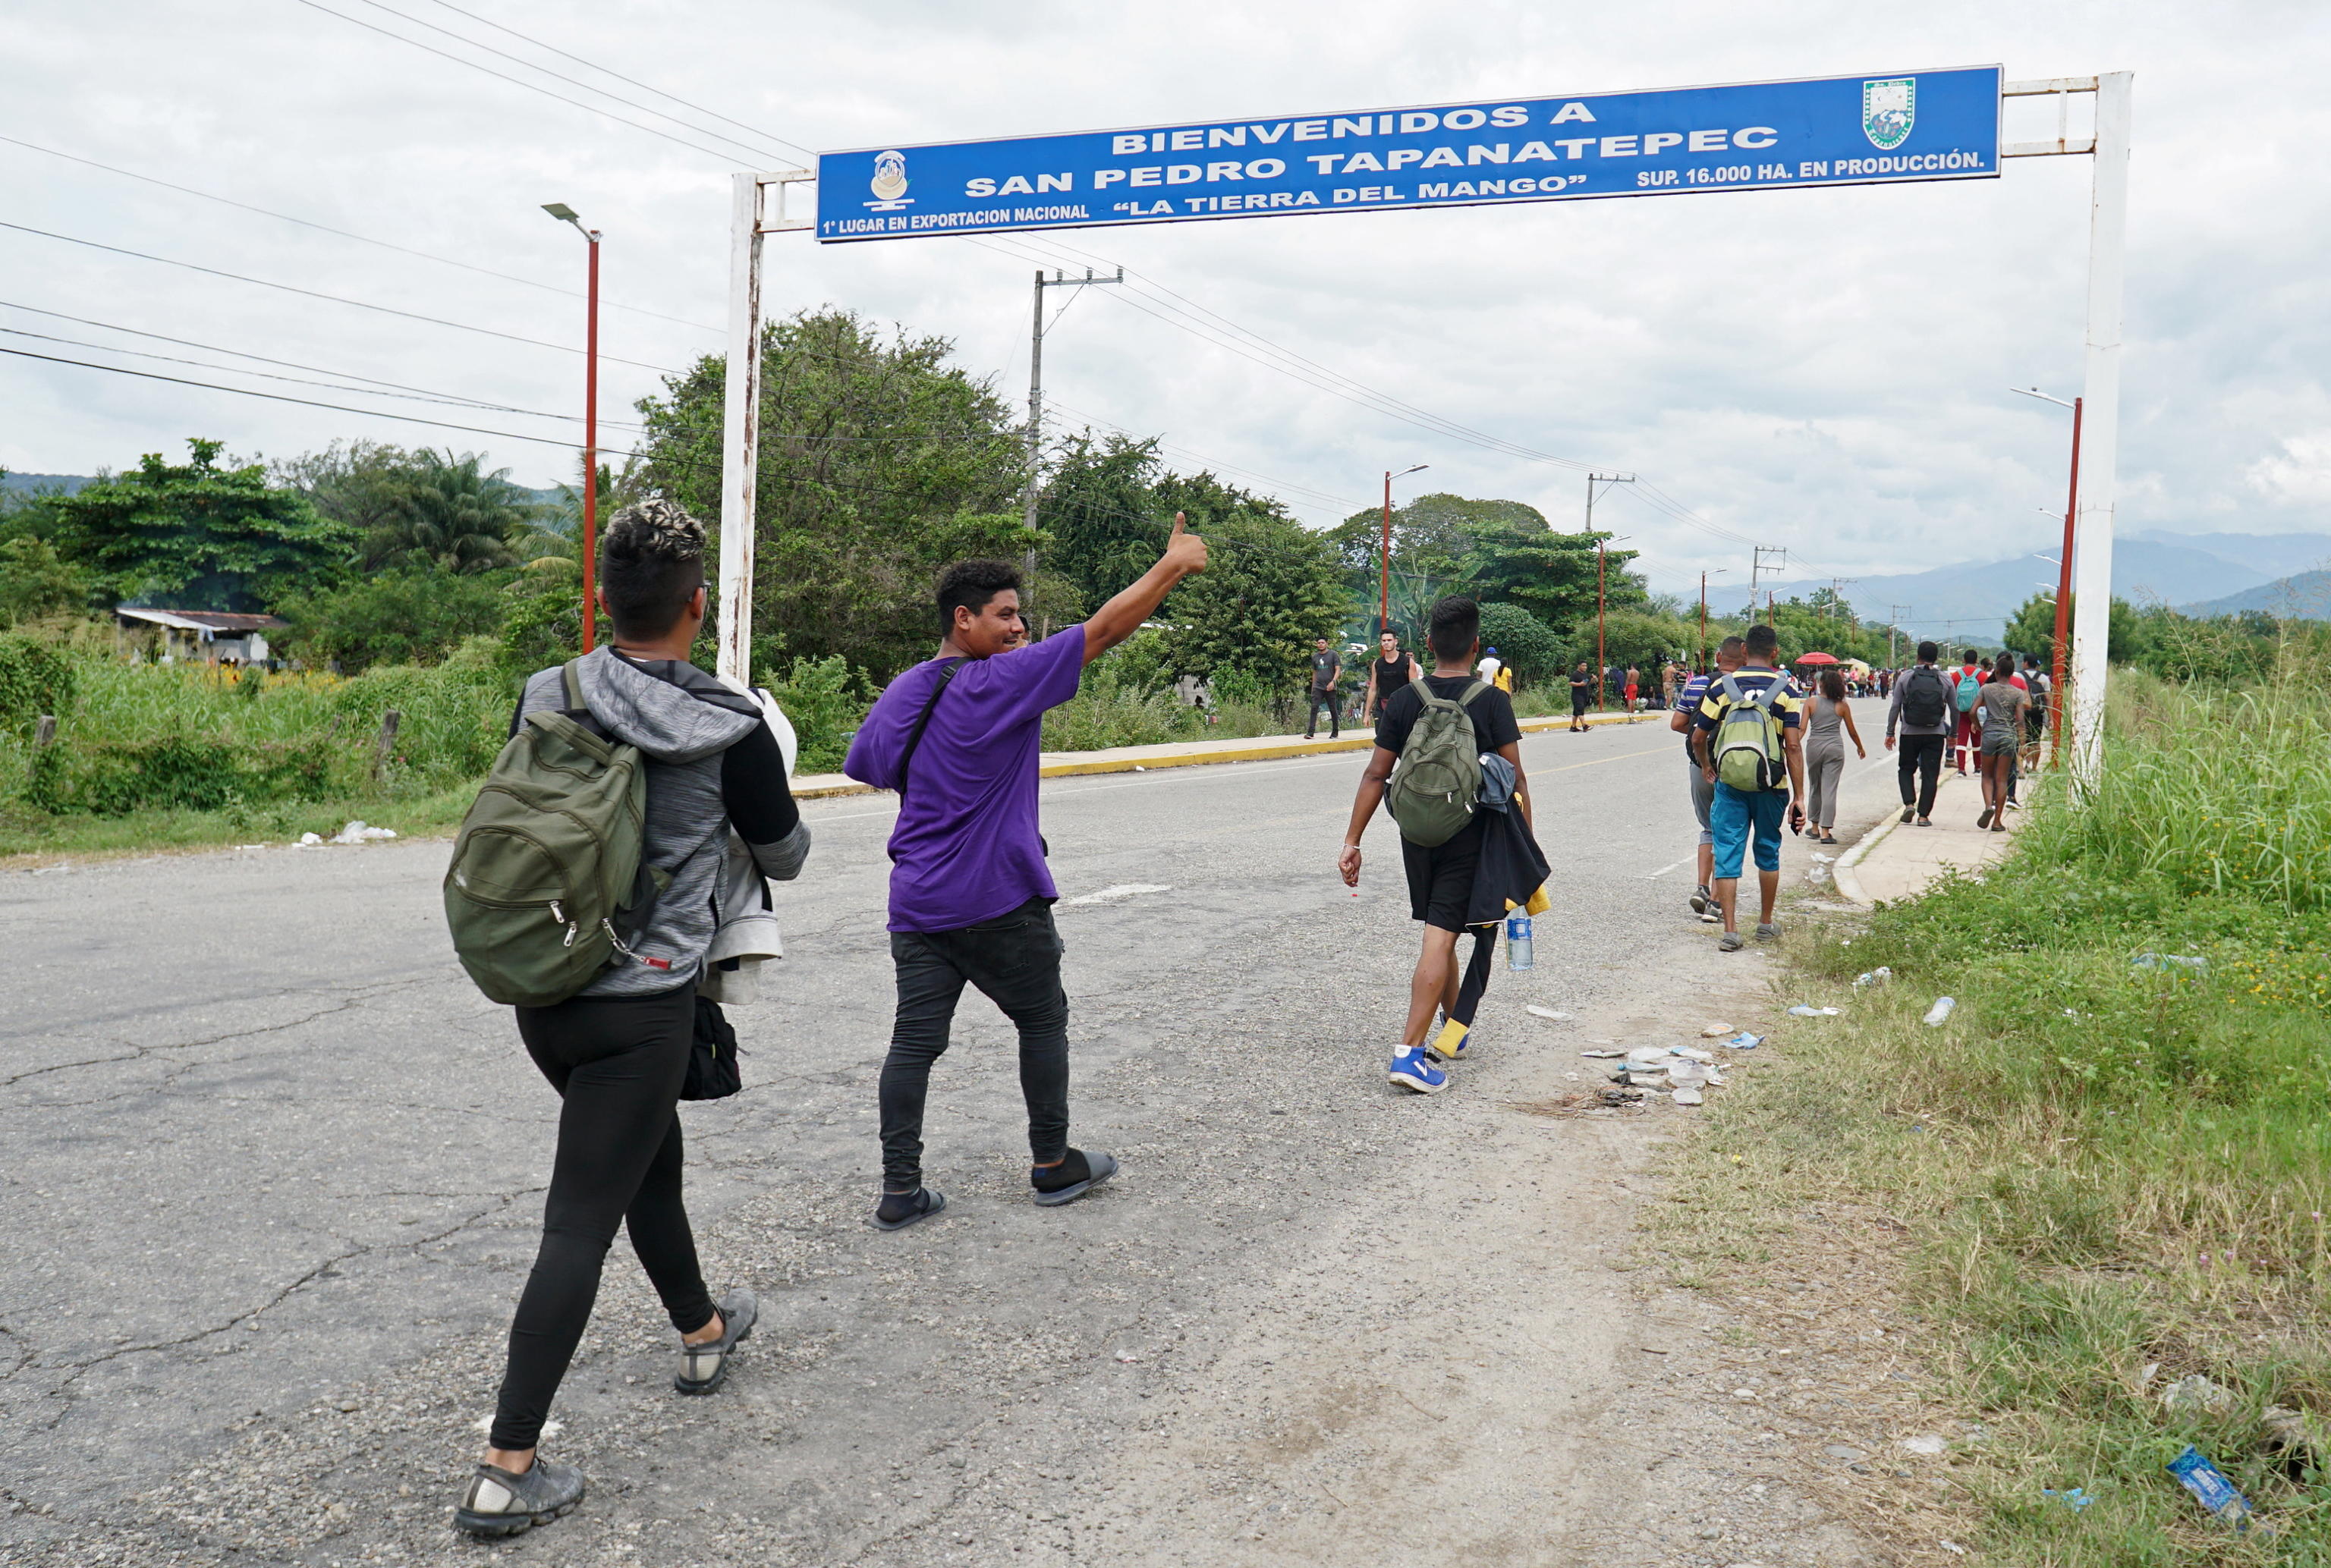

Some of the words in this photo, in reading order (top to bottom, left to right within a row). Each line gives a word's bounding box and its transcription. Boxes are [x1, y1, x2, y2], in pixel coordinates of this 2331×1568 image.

[1112, 105, 1530, 156] BIENVENIDOS
[1549, 102, 1597, 125] A
[964, 172, 1073, 198] SAN
[1093, 158, 1286, 190] PEDRO
[1306, 126, 1779, 175] TAPANATEPEC
[1636, 168, 1681, 188] SUP.
[1685, 165, 1752, 185] 16.000
[1757, 163, 1793, 181] HA.
[1799, 161, 1828, 178] EN
[1834, 148, 1985, 177] PRODUCCIÓN.
[1184, 190, 1321, 212] TIERRA
[1332, 185, 1405, 204] DEL
[838, 218, 886, 234] LUGAR
[888, 216, 908, 231] EN
[911, 209, 1011, 230] EXPORTACION
[1014, 205, 1090, 222] NACIONAL
